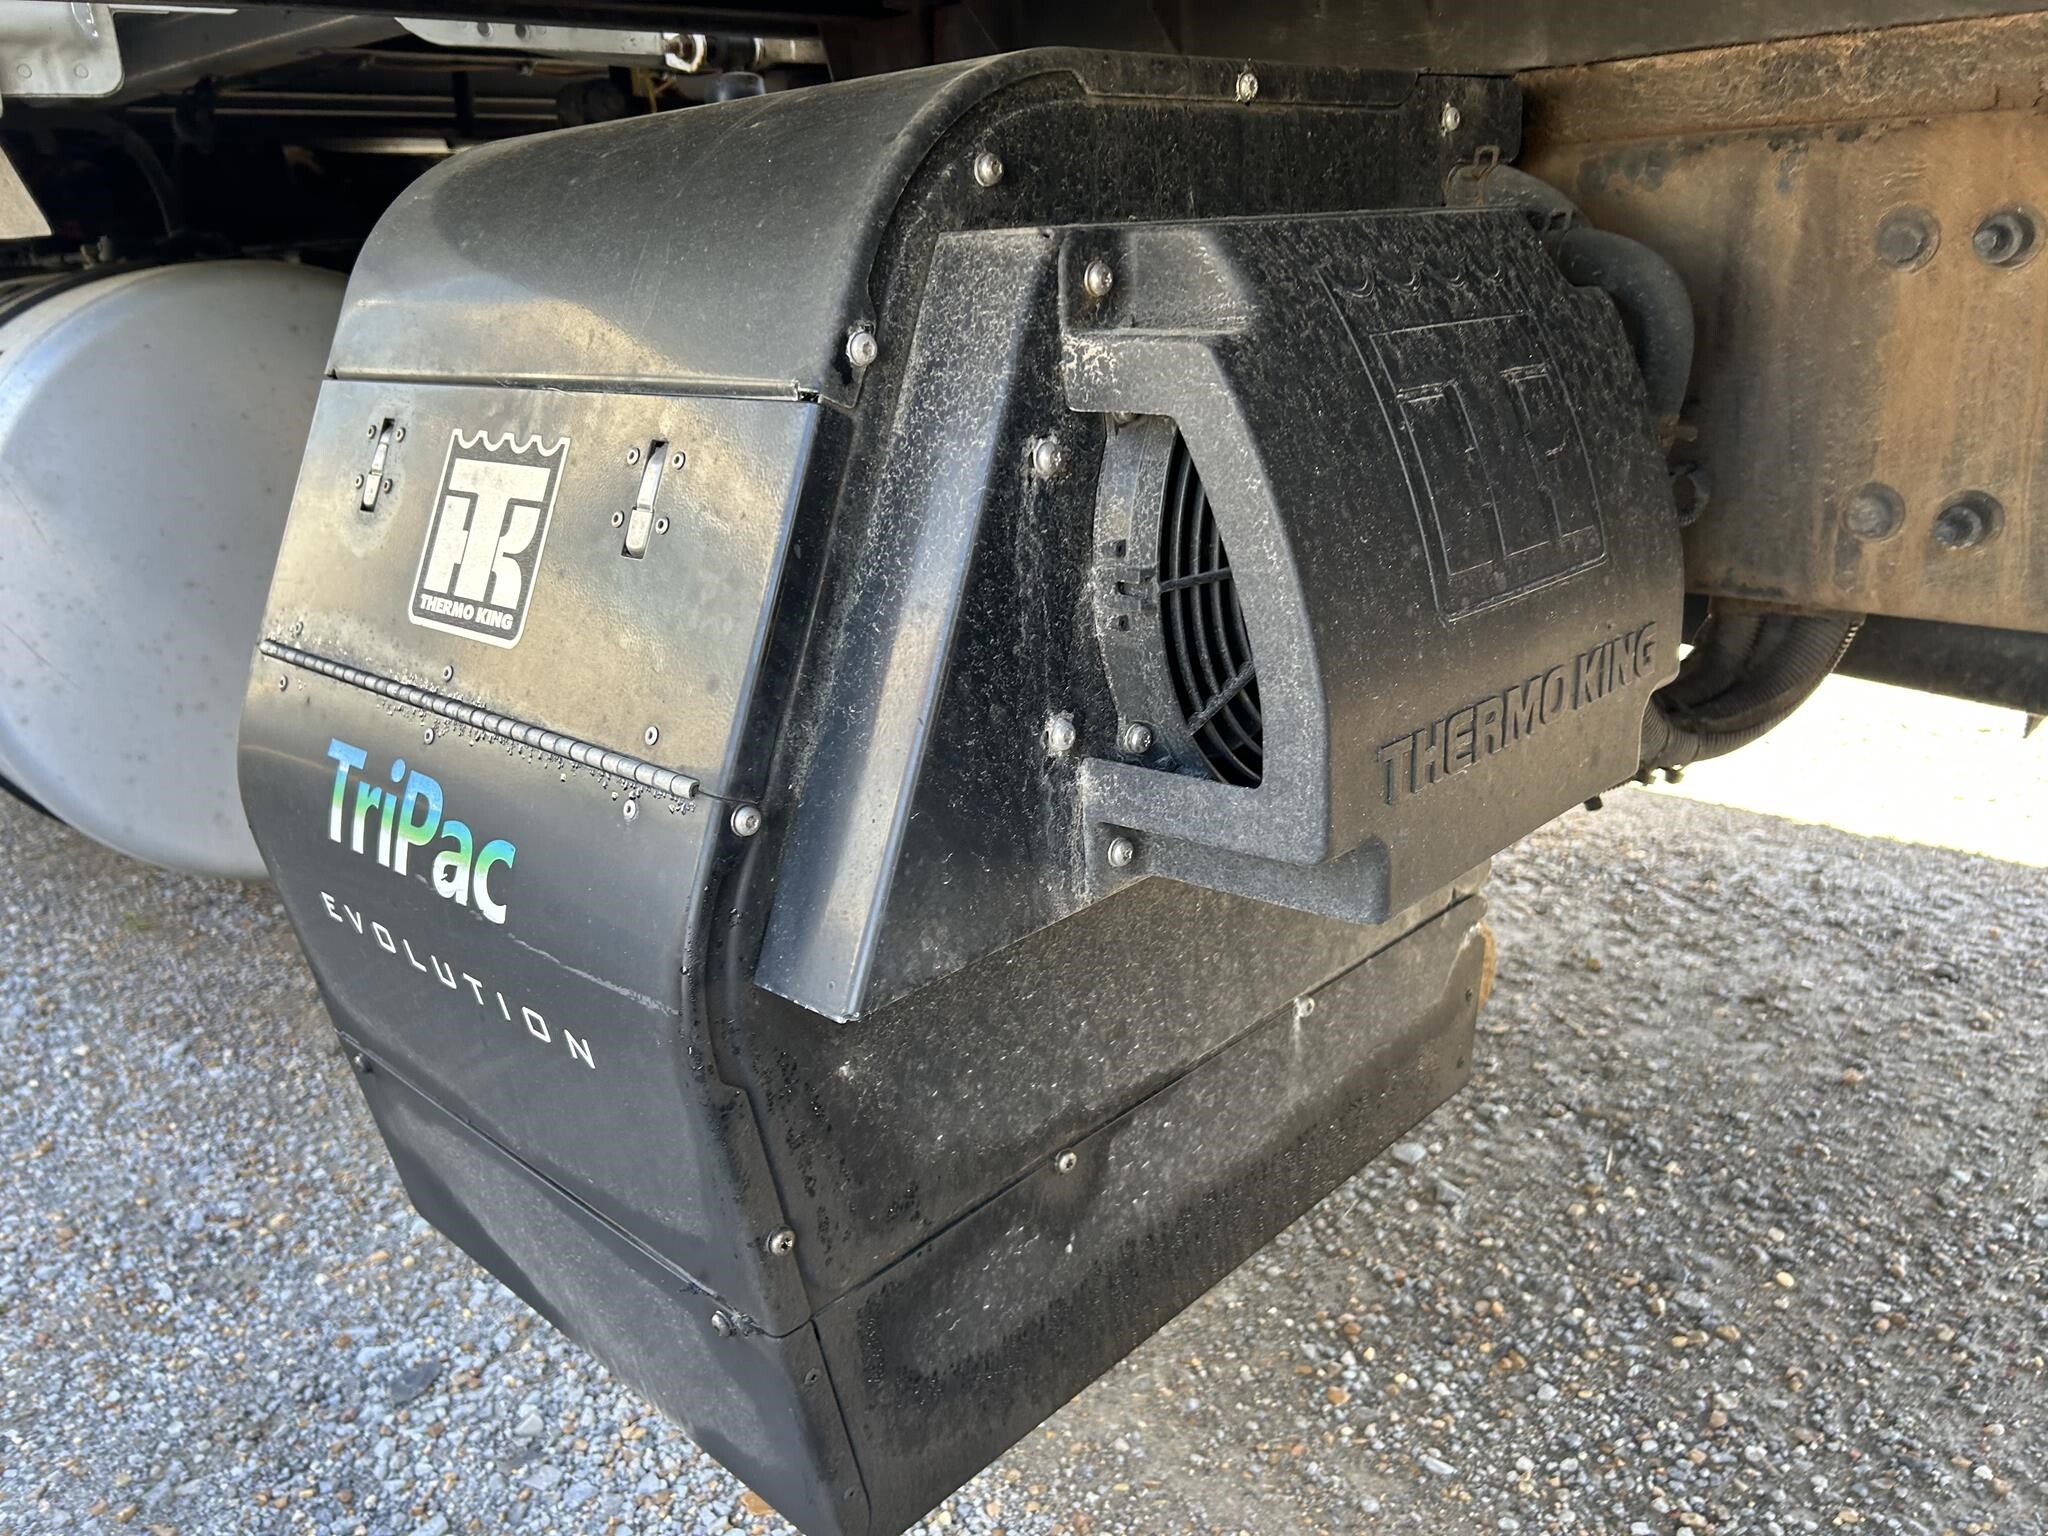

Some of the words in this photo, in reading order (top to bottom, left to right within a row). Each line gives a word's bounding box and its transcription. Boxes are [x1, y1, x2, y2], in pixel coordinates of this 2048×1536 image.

[420, 595, 473, 621] THERMO
[475, 607, 513, 630] KING
[1377, 664, 1565, 805] THERMO
[1572, 621, 1657, 711] KING
[326, 738, 517, 925] TriPac
[320, 891, 596, 1069] EVOLUTION
